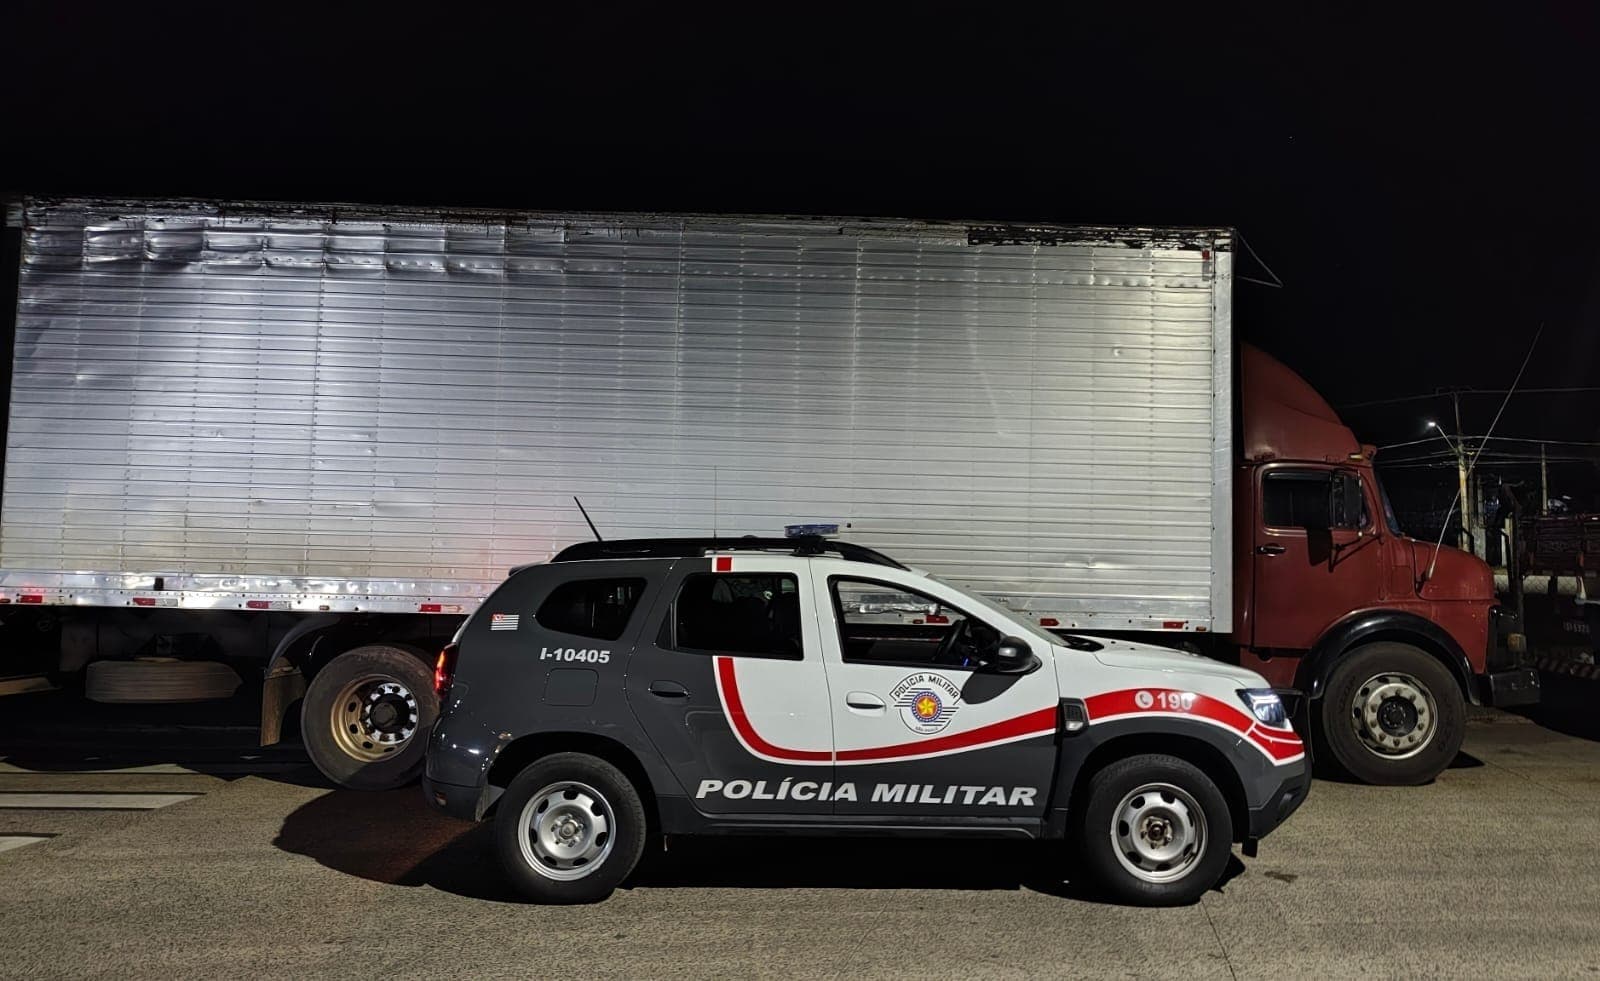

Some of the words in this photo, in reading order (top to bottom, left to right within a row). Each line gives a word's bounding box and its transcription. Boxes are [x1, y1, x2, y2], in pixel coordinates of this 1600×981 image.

[539, 647, 611, 664] I-10405
[927, 675, 959, 699] MILITAR
[1157, 692, 1193, 710] 190
[695, 777, 858, 803] POLÍCIA
[871, 782, 1038, 807] MILITAR
